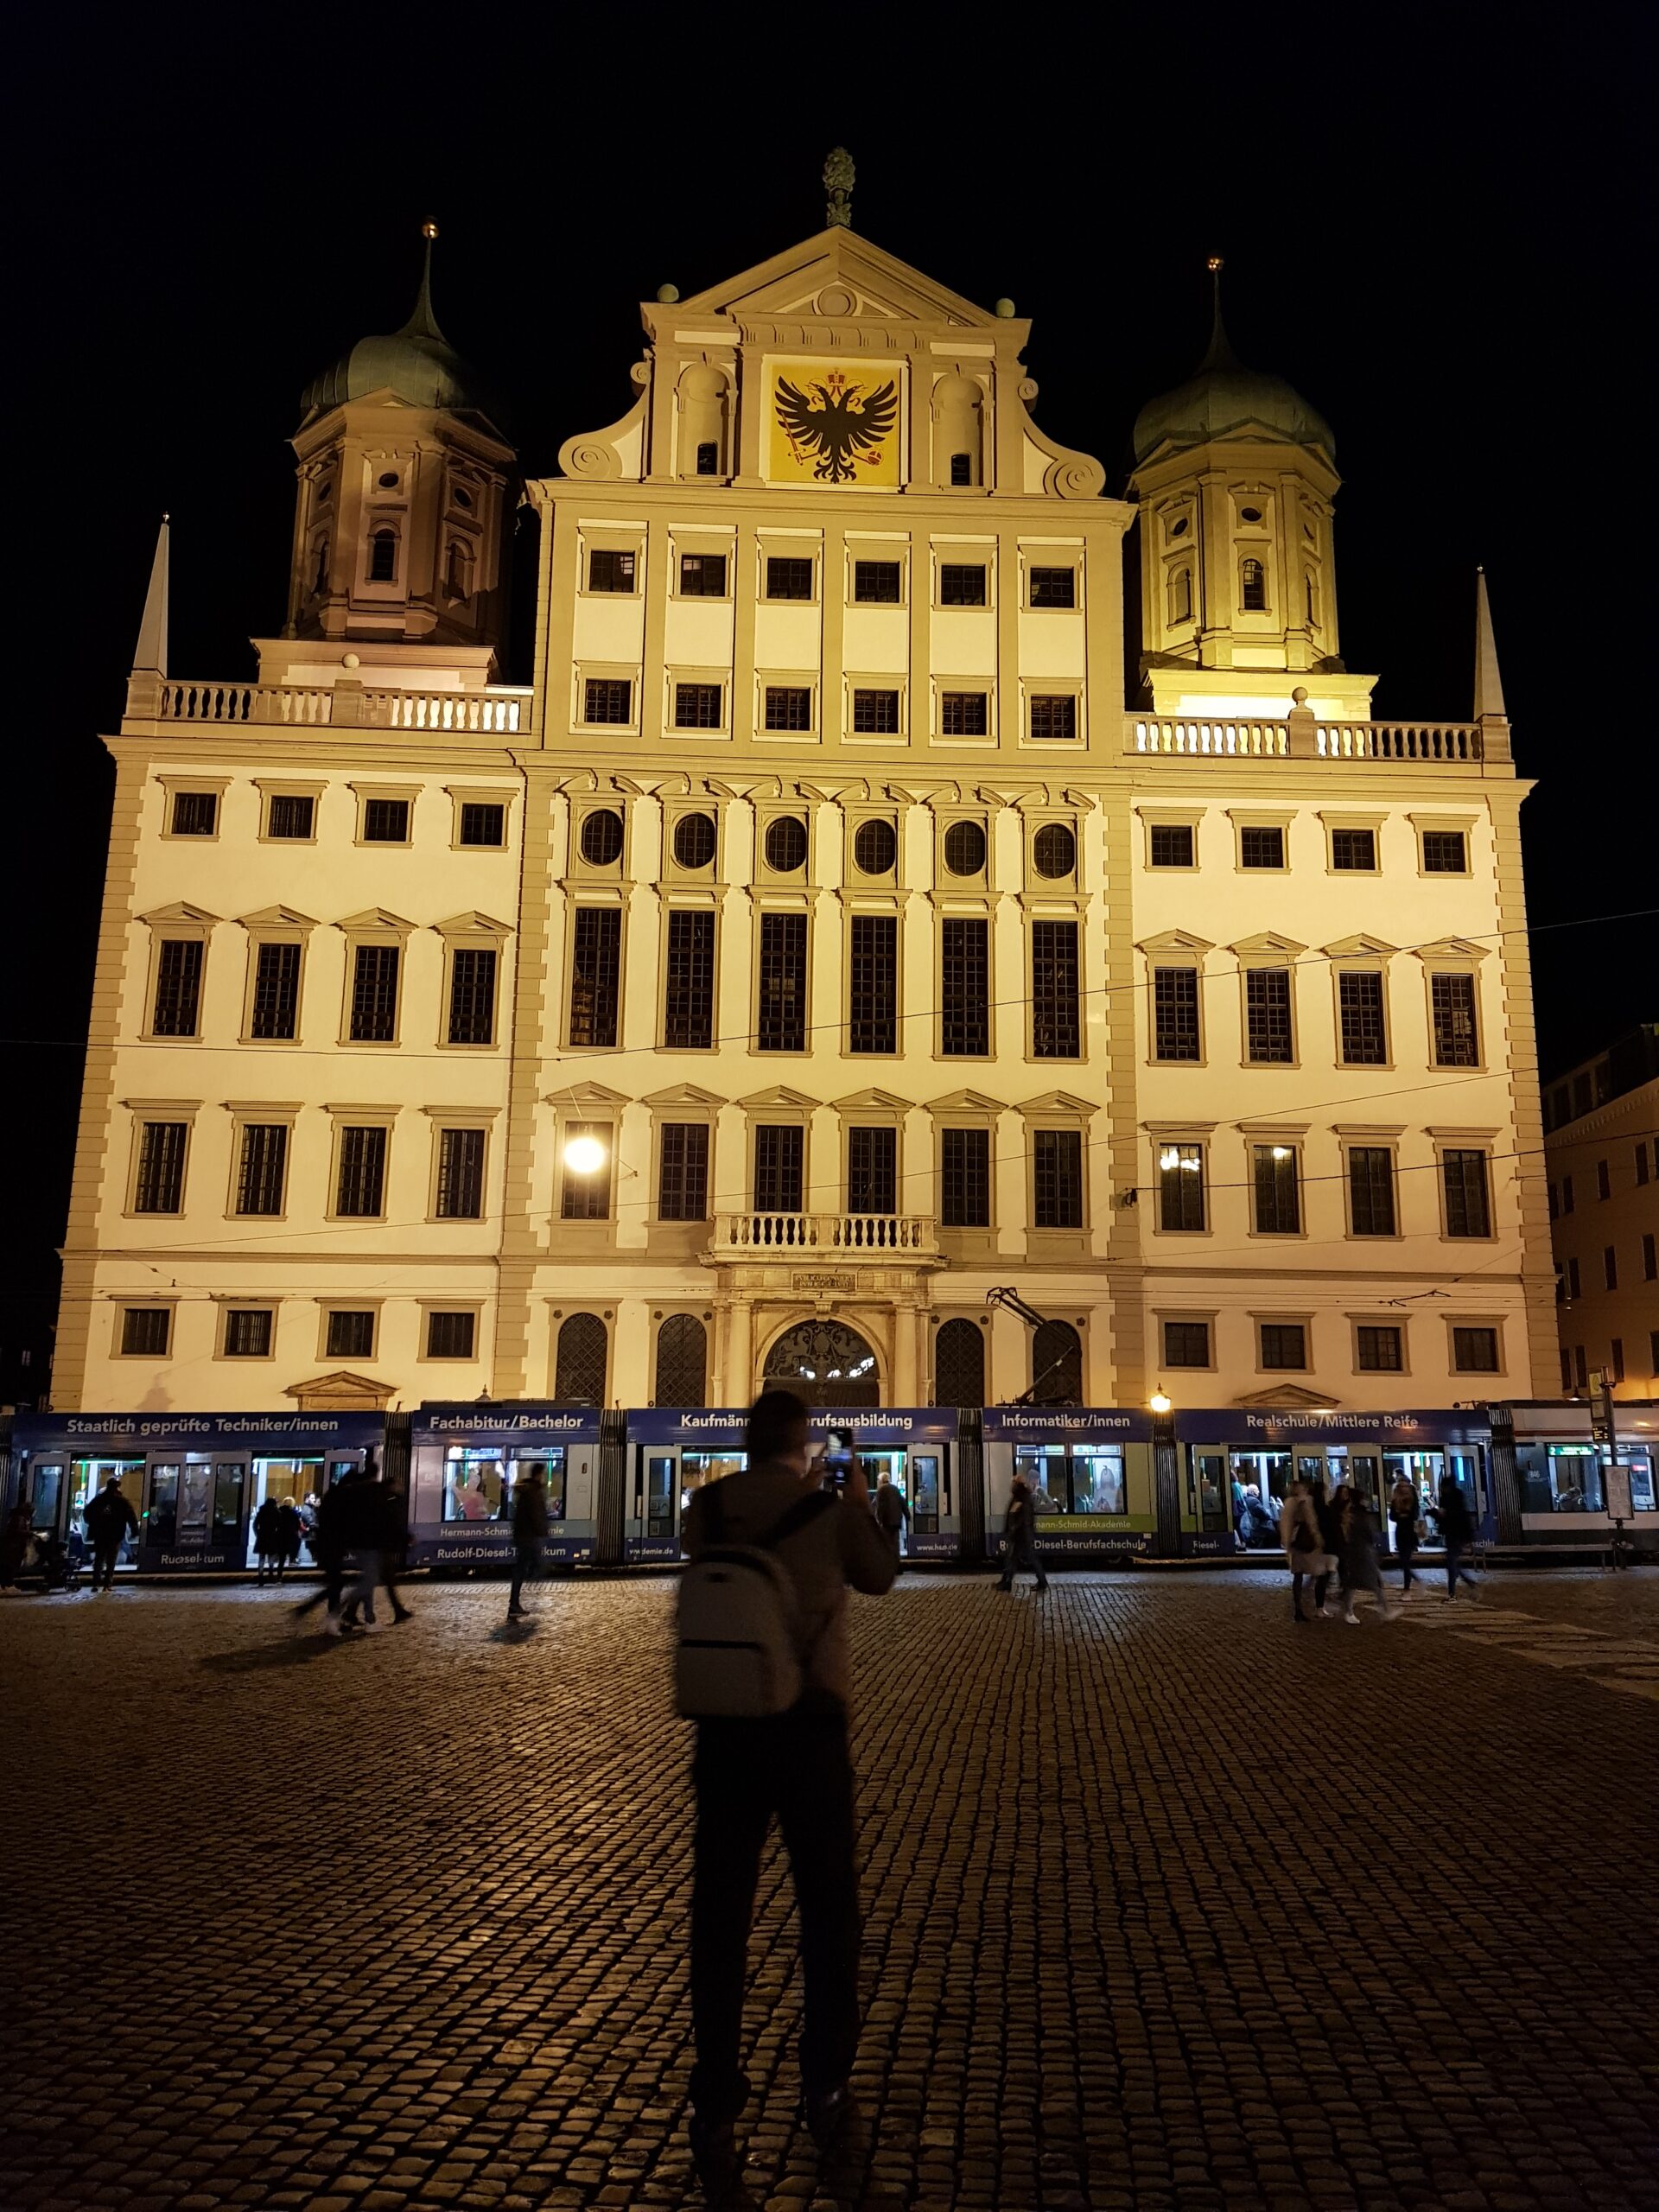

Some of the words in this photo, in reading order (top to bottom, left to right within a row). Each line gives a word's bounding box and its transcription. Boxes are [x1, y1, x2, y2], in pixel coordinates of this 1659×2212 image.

[67, 1419, 135, 1433] Staatlich
[140, 1418, 210, 1436] geprüfte
[215, 1417, 339, 1433] Techniker/innen
[681, 1414, 751, 1427] Kaufmänn
[806, 1414, 912, 1430] rufsausbildung
[1001, 1414, 1130, 1428] Informatiker/innen
[1246, 1414, 1380, 1428] Realschule/Mittlere
[1383, 1414, 1419, 1428] Reife
